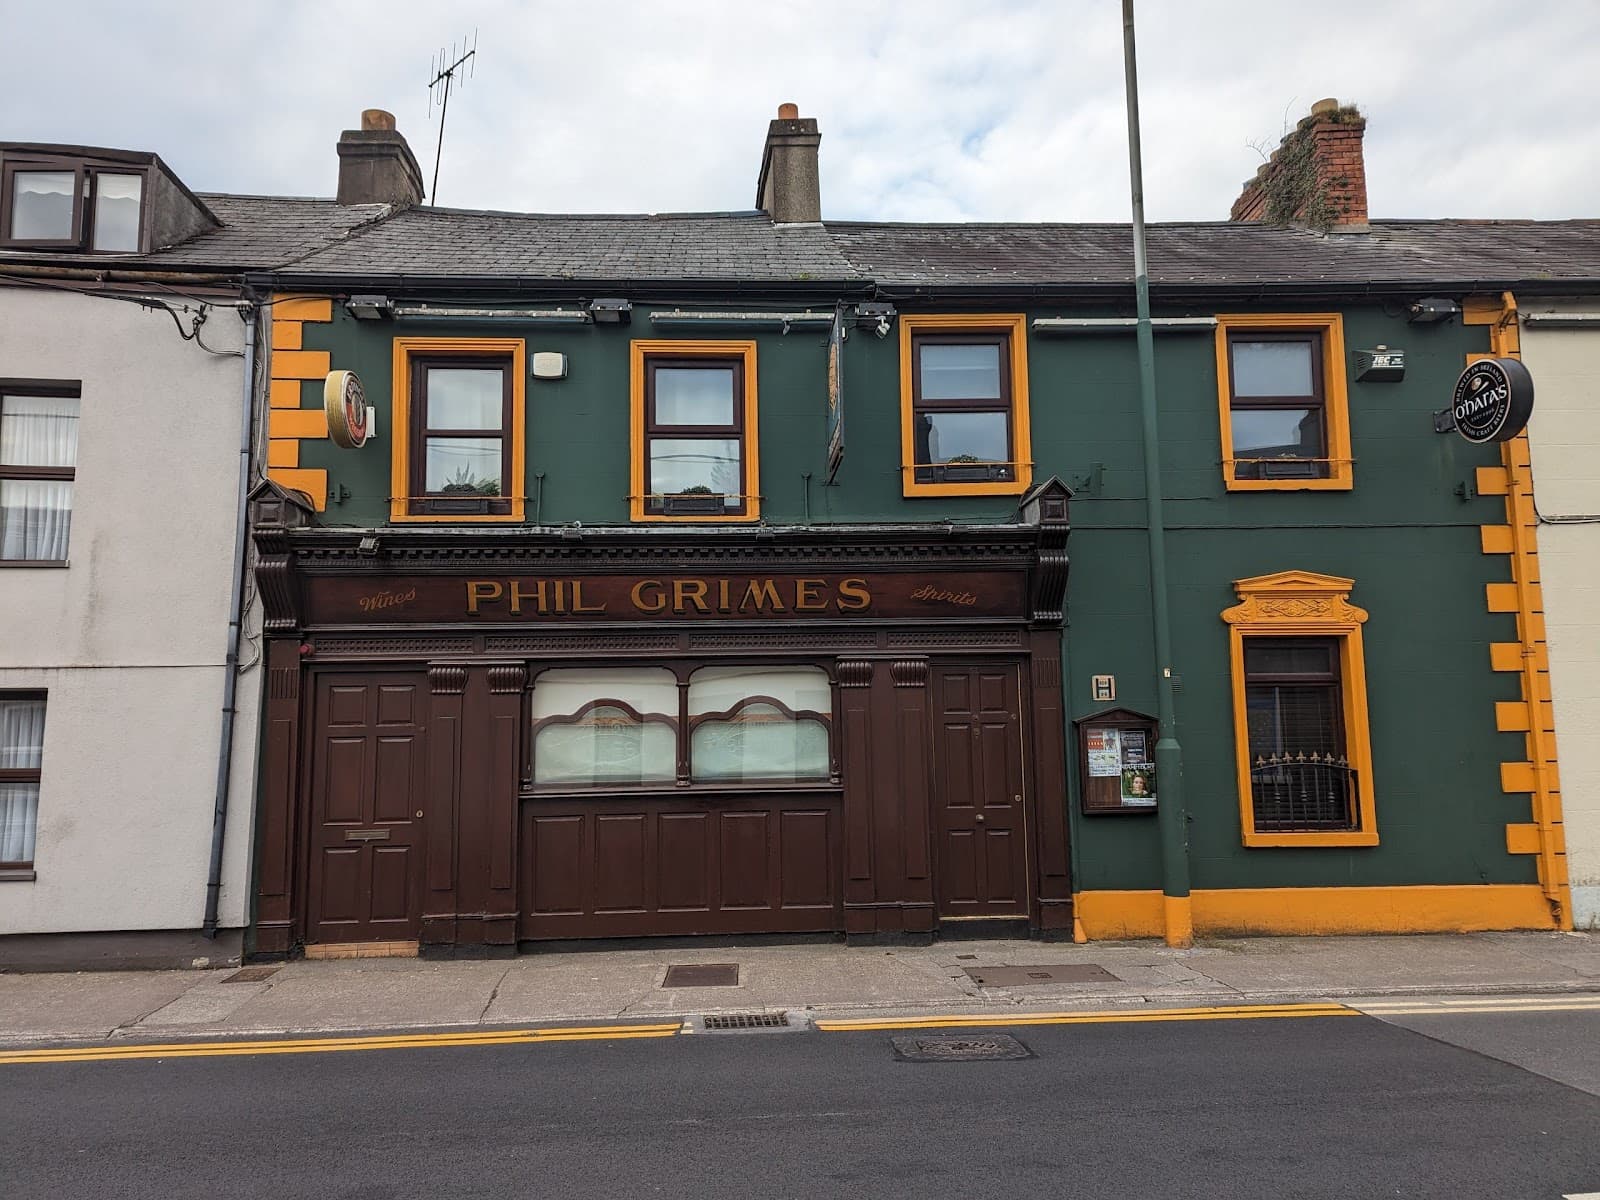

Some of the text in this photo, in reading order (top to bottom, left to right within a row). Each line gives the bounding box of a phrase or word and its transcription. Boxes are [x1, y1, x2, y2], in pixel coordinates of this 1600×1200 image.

[359, 587, 416, 611] Wines
[466, 578, 872, 614] PHIL GRIMES
[910, 584, 977, 606] Spirits
